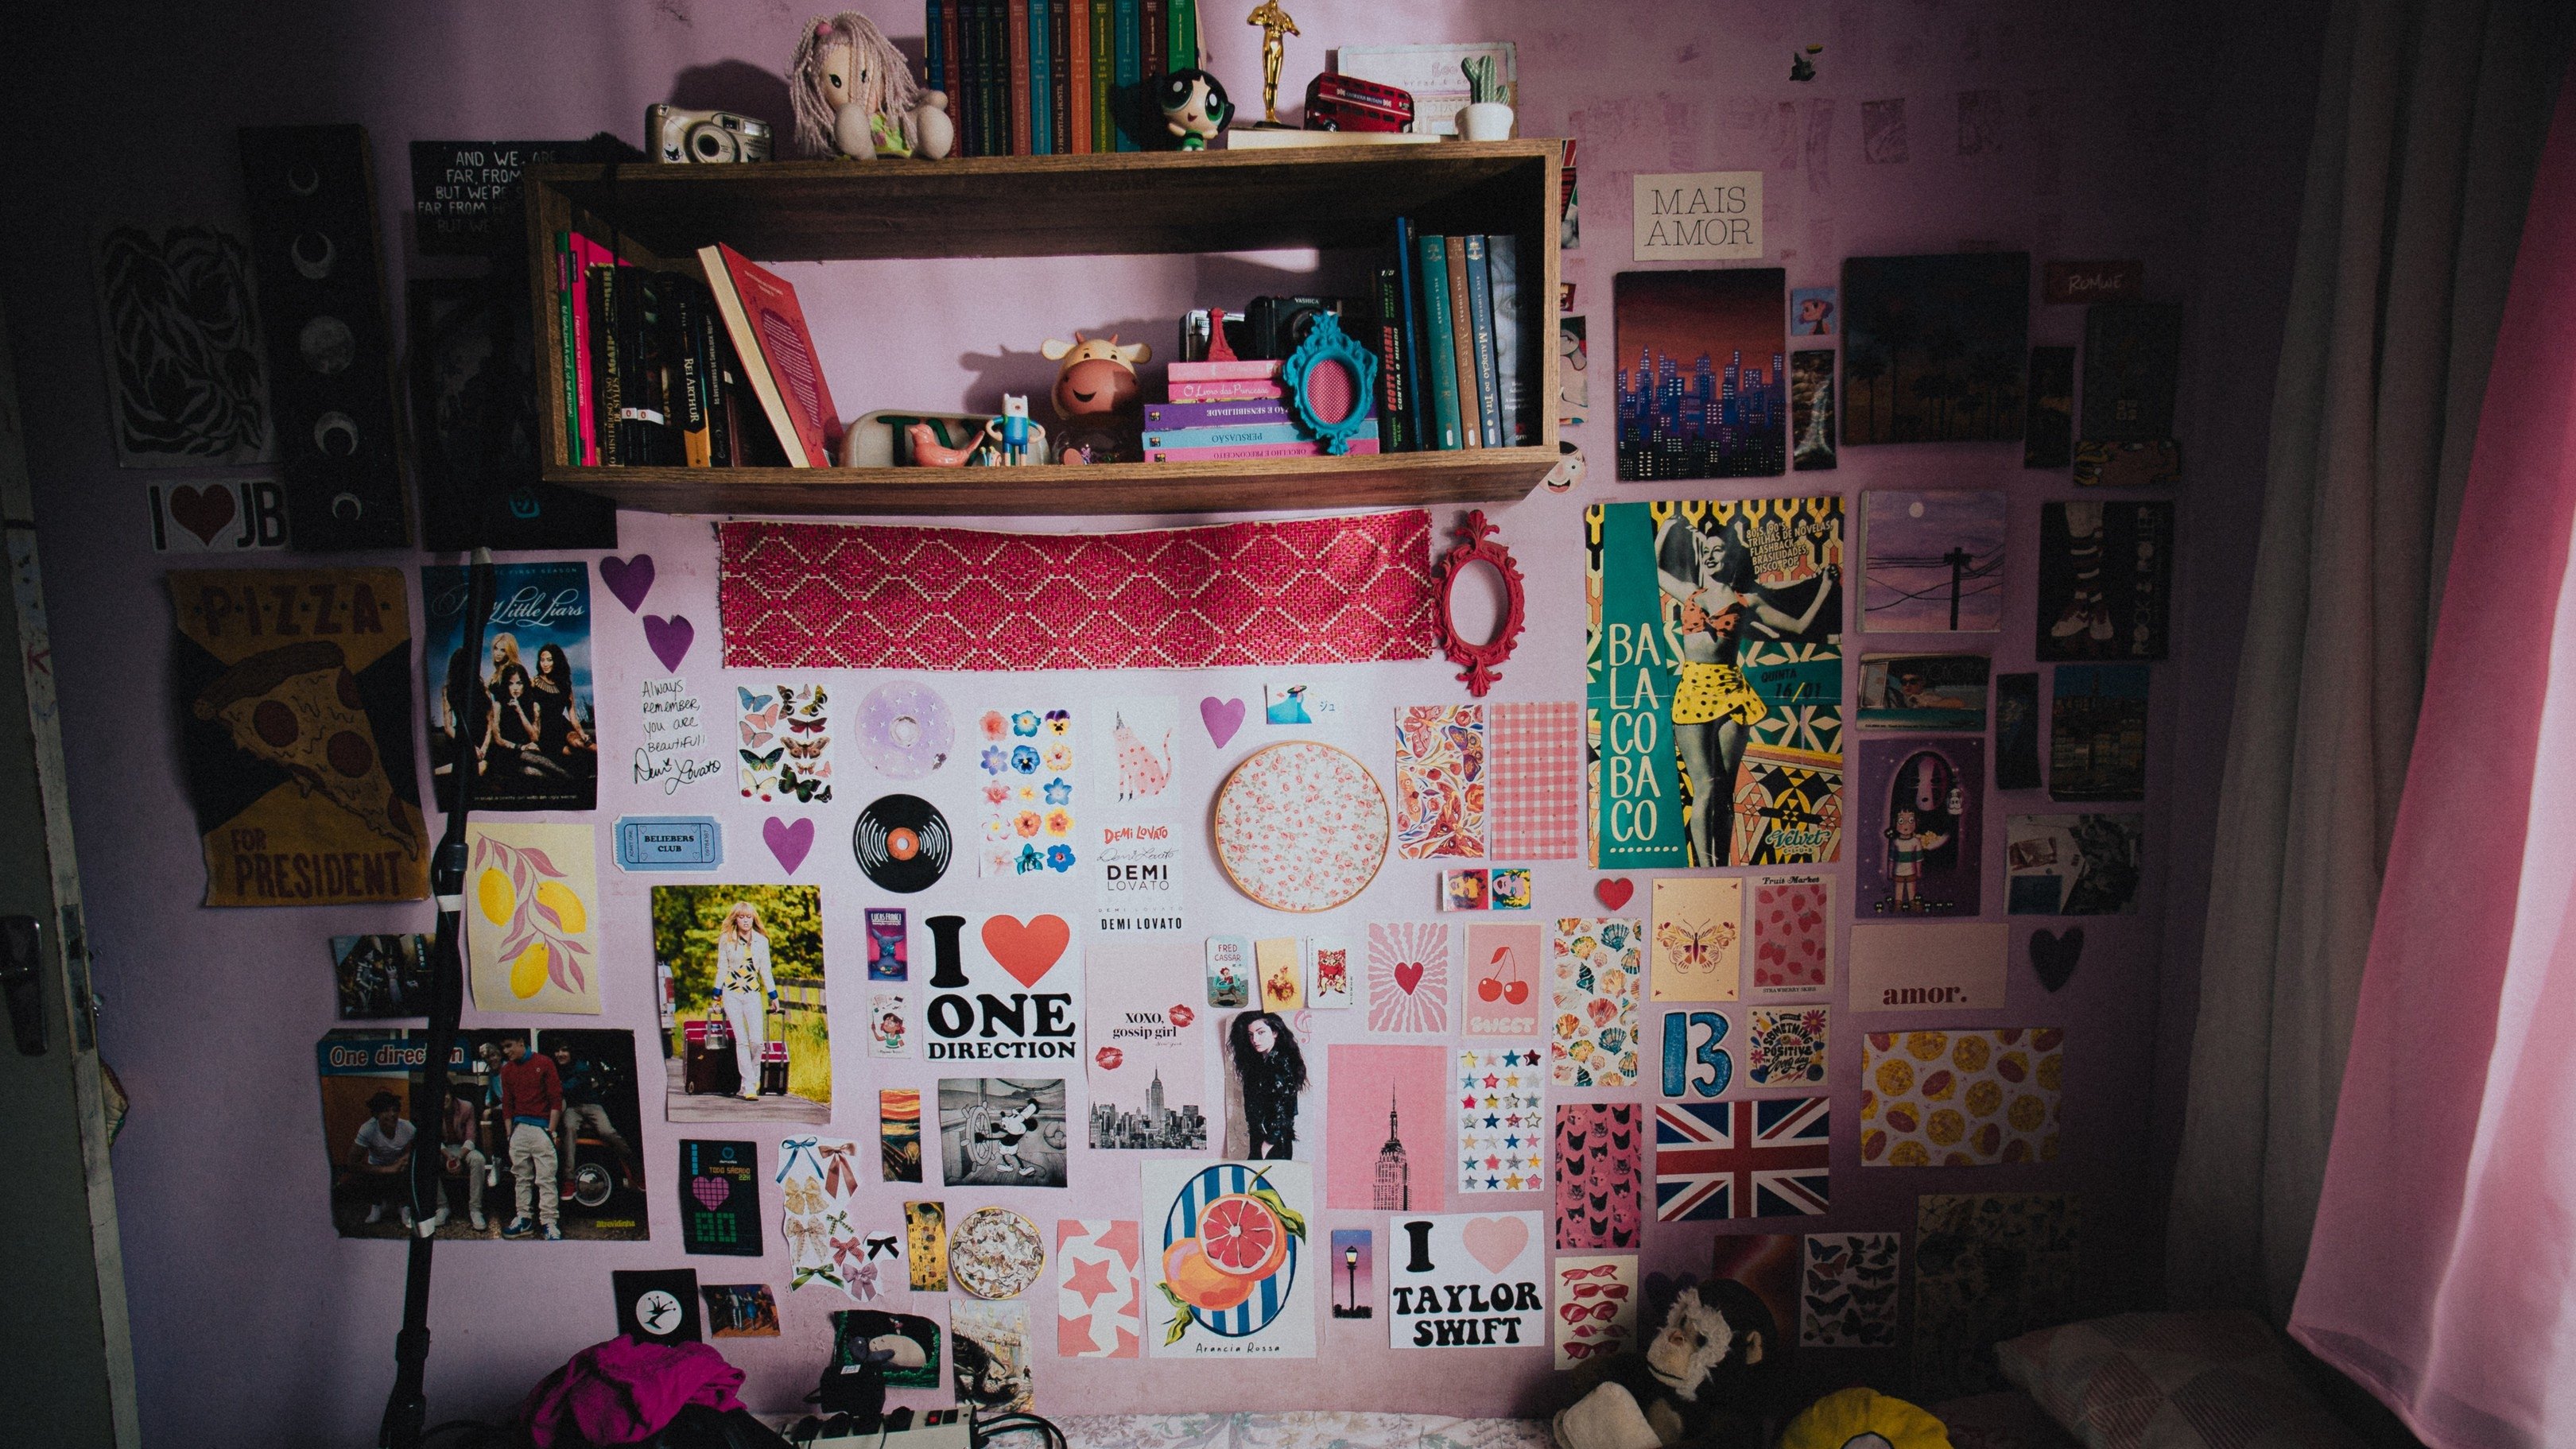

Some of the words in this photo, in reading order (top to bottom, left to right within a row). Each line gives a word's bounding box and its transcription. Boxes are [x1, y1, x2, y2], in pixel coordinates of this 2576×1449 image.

[1366, 96, 1383, 105] BRITAIN
[456, 151, 484, 166] AND
[494, 151, 518, 166] WE
[446, 169, 474, 183] FAR
[482, 169, 522, 183] FROM
[436, 186, 460, 200] BUT
[1651, 187, 1748, 215] MAIS
[418, 201, 441, 215] FAR
[449, 201, 487, 215] FROM
[1643, 217, 1753, 247] AMOR
[1479, 332, 1492, 379] MALDIÇÃO
[683, 358, 695, 375] REI
[1183, 385, 1193, 397] O
[1195, 383, 1219, 397] Livro
[1220, 385, 1232, 394] das
[1233, 384, 1269, 395] Princesas
[1387, 374, 1397, 413] SCOTT
[1484, 382, 1491, 392] DO
[685, 377, 700, 423] ARTHUR
[1484, 393, 1494, 414] TITÃ
[1206, 407, 1266, 417] SENSIBILIDADE
[1212, 433, 1263, 443] PERSUASÃO
[149, 486, 166, 550] I
[237, 481, 289, 548] JB
[1748, 532, 1780, 548] TRILHAS
[1783, 529, 1793, 541] DE
[1794, 520, 1833, 537] NOVELAS,
[1750, 539, 1796, 556] FLASHBACK,
[1752, 544, 1809, 566] BRASILIDADES,
[487, 586, 547, 625] Little
[516, 588, 584, 628] Liars
[1609, 623, 1662, 668] BA
[1761, 668, 1797, 683] QUINTA
[1610, 667, 1659, 711] LA
[1320, 700, 1336, 712] ジュ
[1610, 712, 1658, 755] CO
[1610, 756, 1662, 799] BA
[1136, 825, 1168, 839] LOVATO
[1610, 800, 1658, 843] CO
[231, 829, 267, 850] FOR
[1767, 829, 1831, 848] Velvet
[658, 845, 682, 854] CLUB
[235, 852, 405, 900] PRESIDENT
[1107, 865, 1167, 880] DEMI
[1108, 881, 1170, 891] LOVATO
[1101, 919, 1131, 930] DEMI
[1137, 917, 1182, 930] LOVATO
[925, 915, 969, 988] I
[1218, 943, 1238, 952] FRED
[1882, 983, 1968, 1005] amor.
[927, 993, 1077, 1038] ONE
[1125, 1013, 1164, 1025] XOXO,
[1470, 1016, 1534, 1033] SWEET
[1112, 1027, 1153, 1040] gossip
[1154, 1025, 1177, 1040] girl
[1763, 1023, 1813, 1045] SOMETHING
[330, 1046, 368, 1066] One
[375, 1044, 465, 1066] direcn
[928, 1041, 1077, 1059] DIRECTION
[1662, 1010, 1733, 1098] 13
[1763, 1046, 1813, 1057] POSITIVE
[596, 1220, 636, 1229] atrevidinha
[695, 1212, 738, 1243] 80
[1403, 1221, 1435, 1273] I
[1392, 1282, 1543, 1316] TAYLOR
[1413, 1318, 1522, 1346] SWIFT
[1196, 1342, 1243, 1354] Arancia
[1247, 1342, 1281, 1354] Rossa
